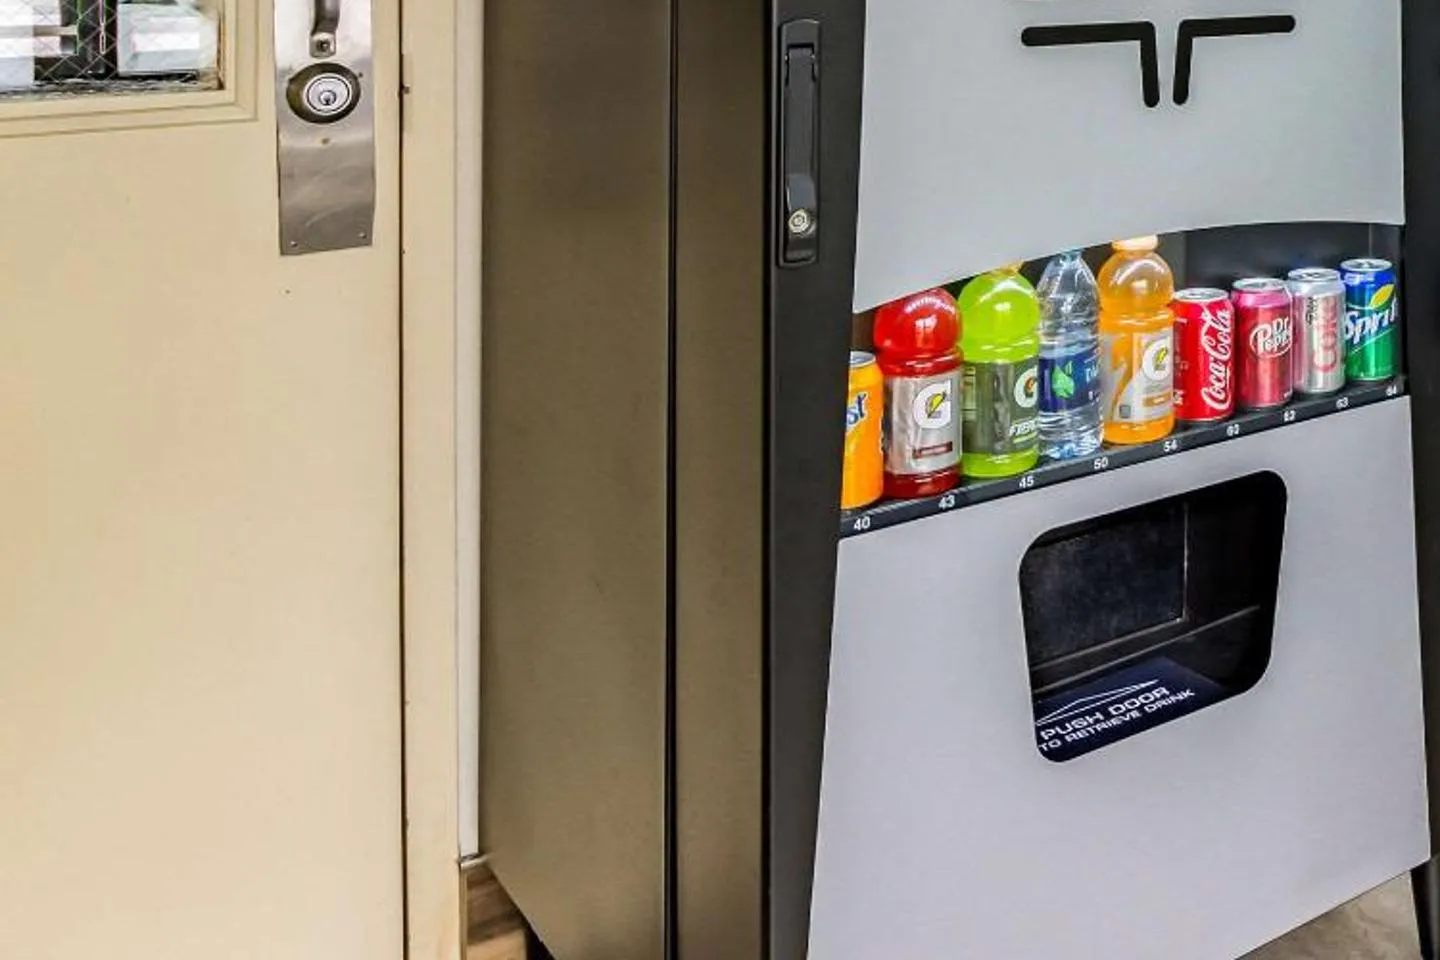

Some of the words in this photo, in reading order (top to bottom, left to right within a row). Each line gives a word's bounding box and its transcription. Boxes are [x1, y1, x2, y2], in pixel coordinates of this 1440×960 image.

[1093, 457, 1109, 471] 50
[1018, 476, 1034, 490] 45
[939, 495, 955, 510] 43
[853, 516, 871, 531] 40
[1039, 738, 1062, 752] TO
[1065, 711, 1143, 742] RETRIEVE
[1144, 689, 1196, 714] DRINK
[1040, 711, 1105, 740] PUSH
[1108, 686, 1170, 716] DOOR
